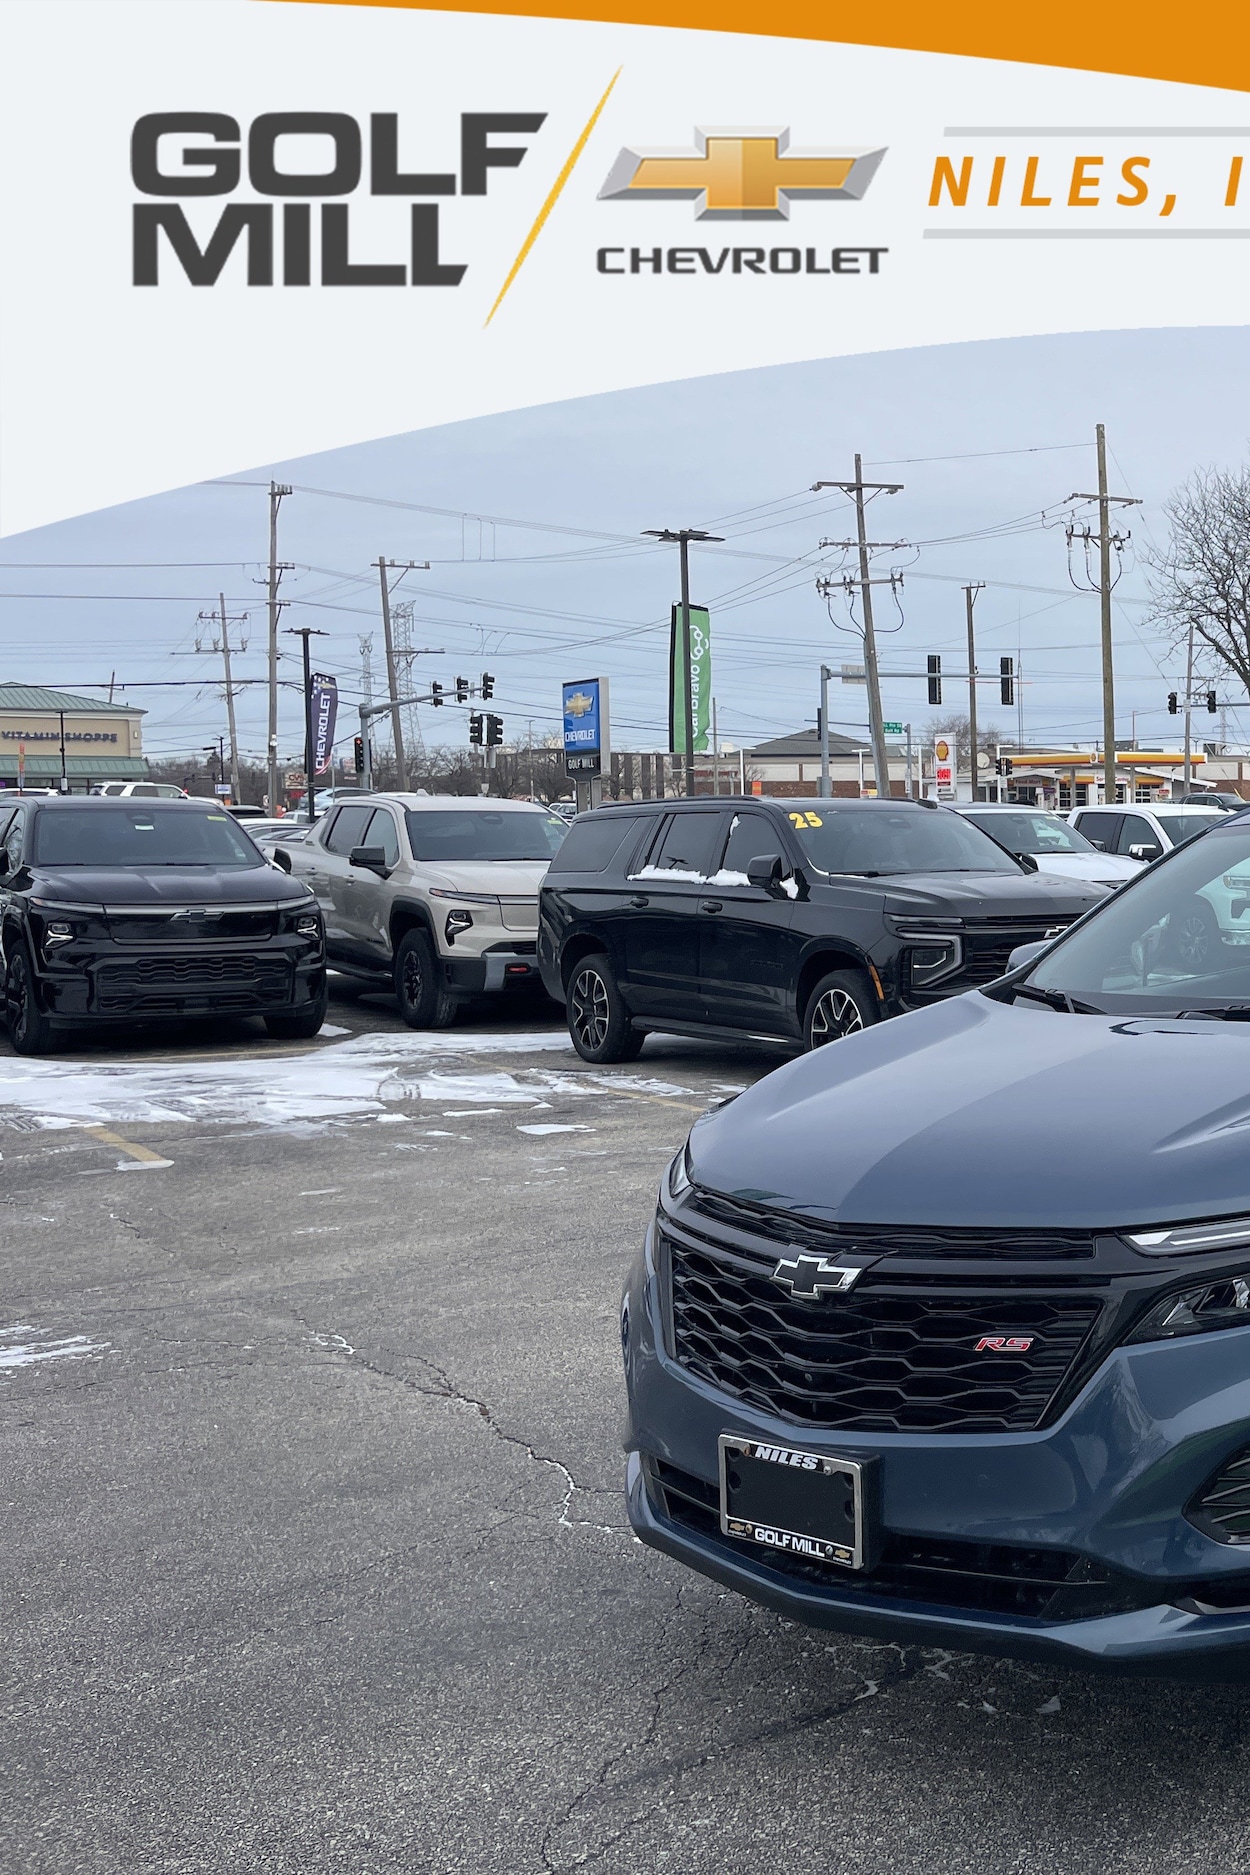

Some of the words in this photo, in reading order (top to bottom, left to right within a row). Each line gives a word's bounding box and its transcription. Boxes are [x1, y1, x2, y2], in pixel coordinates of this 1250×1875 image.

[2, 731, 60, 741] VITAMIN
[65, 732, 118, 743] SHOPPE
[315, 693, 330, 769] CHEVROLET
[565, 729, 596, 742] CHEVROLET
[788, 811, 823, 829] 25
[974, 1336, 1034, 1352] RS
[755, 1446, 818, 1470] NILES
[754, 1528, 791, 1548] GOLF
[791, 1537, 826, 1558] MILL
